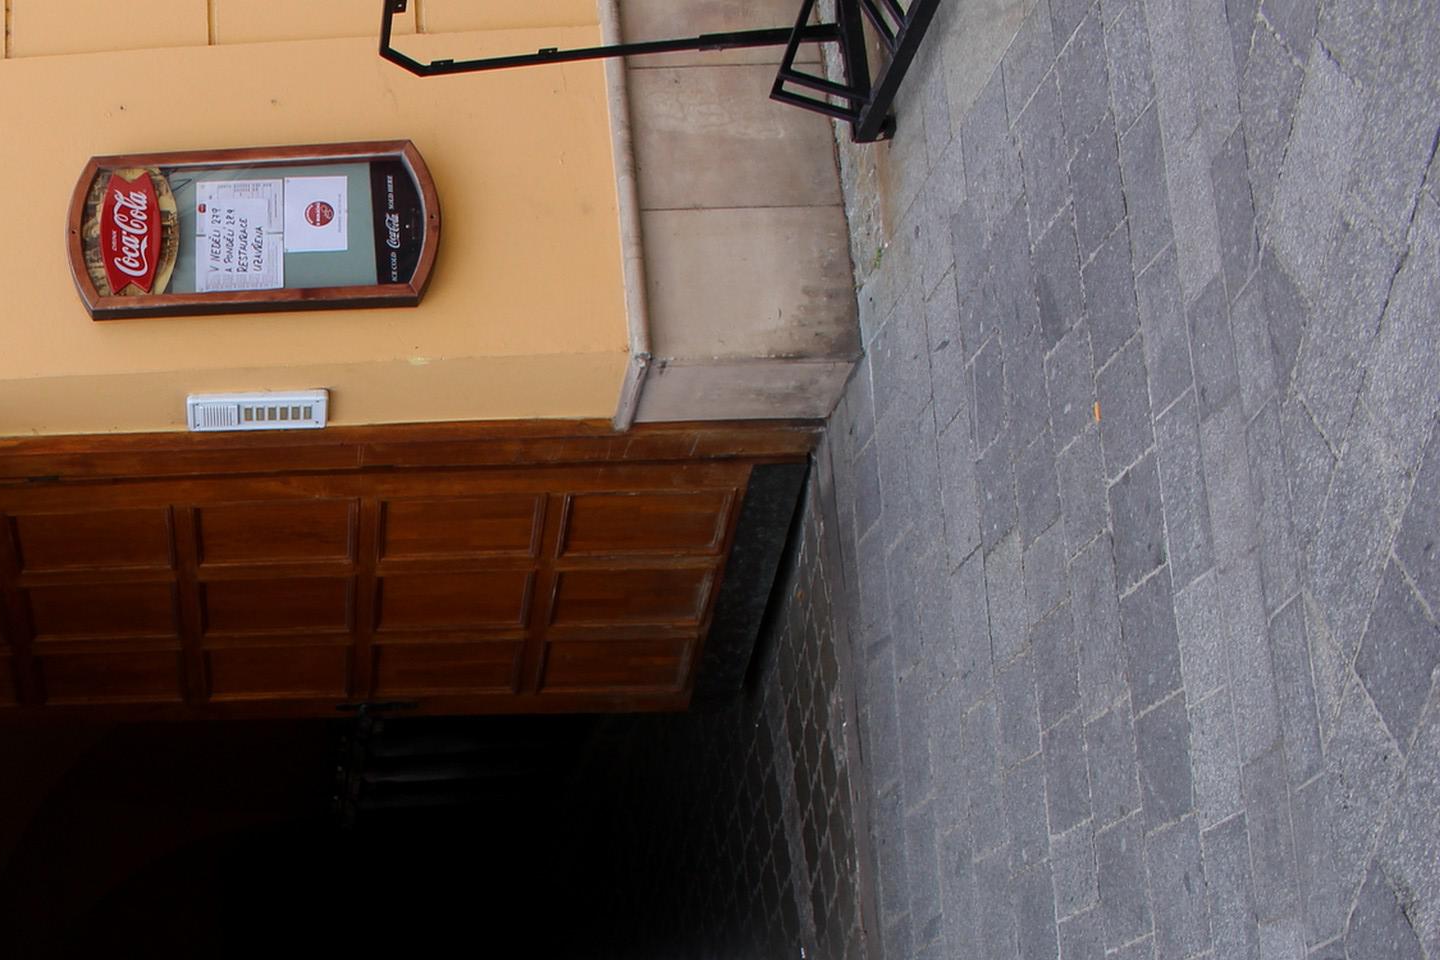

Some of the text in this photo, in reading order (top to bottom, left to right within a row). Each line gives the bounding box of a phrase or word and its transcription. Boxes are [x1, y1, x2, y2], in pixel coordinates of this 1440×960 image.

[113, 189, 148, 276] Coca-Cola
[236, 218, 248, 272] RESTAURACE
[251, 225, 263, 272] UZAVŘENA
[385, 212, 400, 248] Coca-Cola
